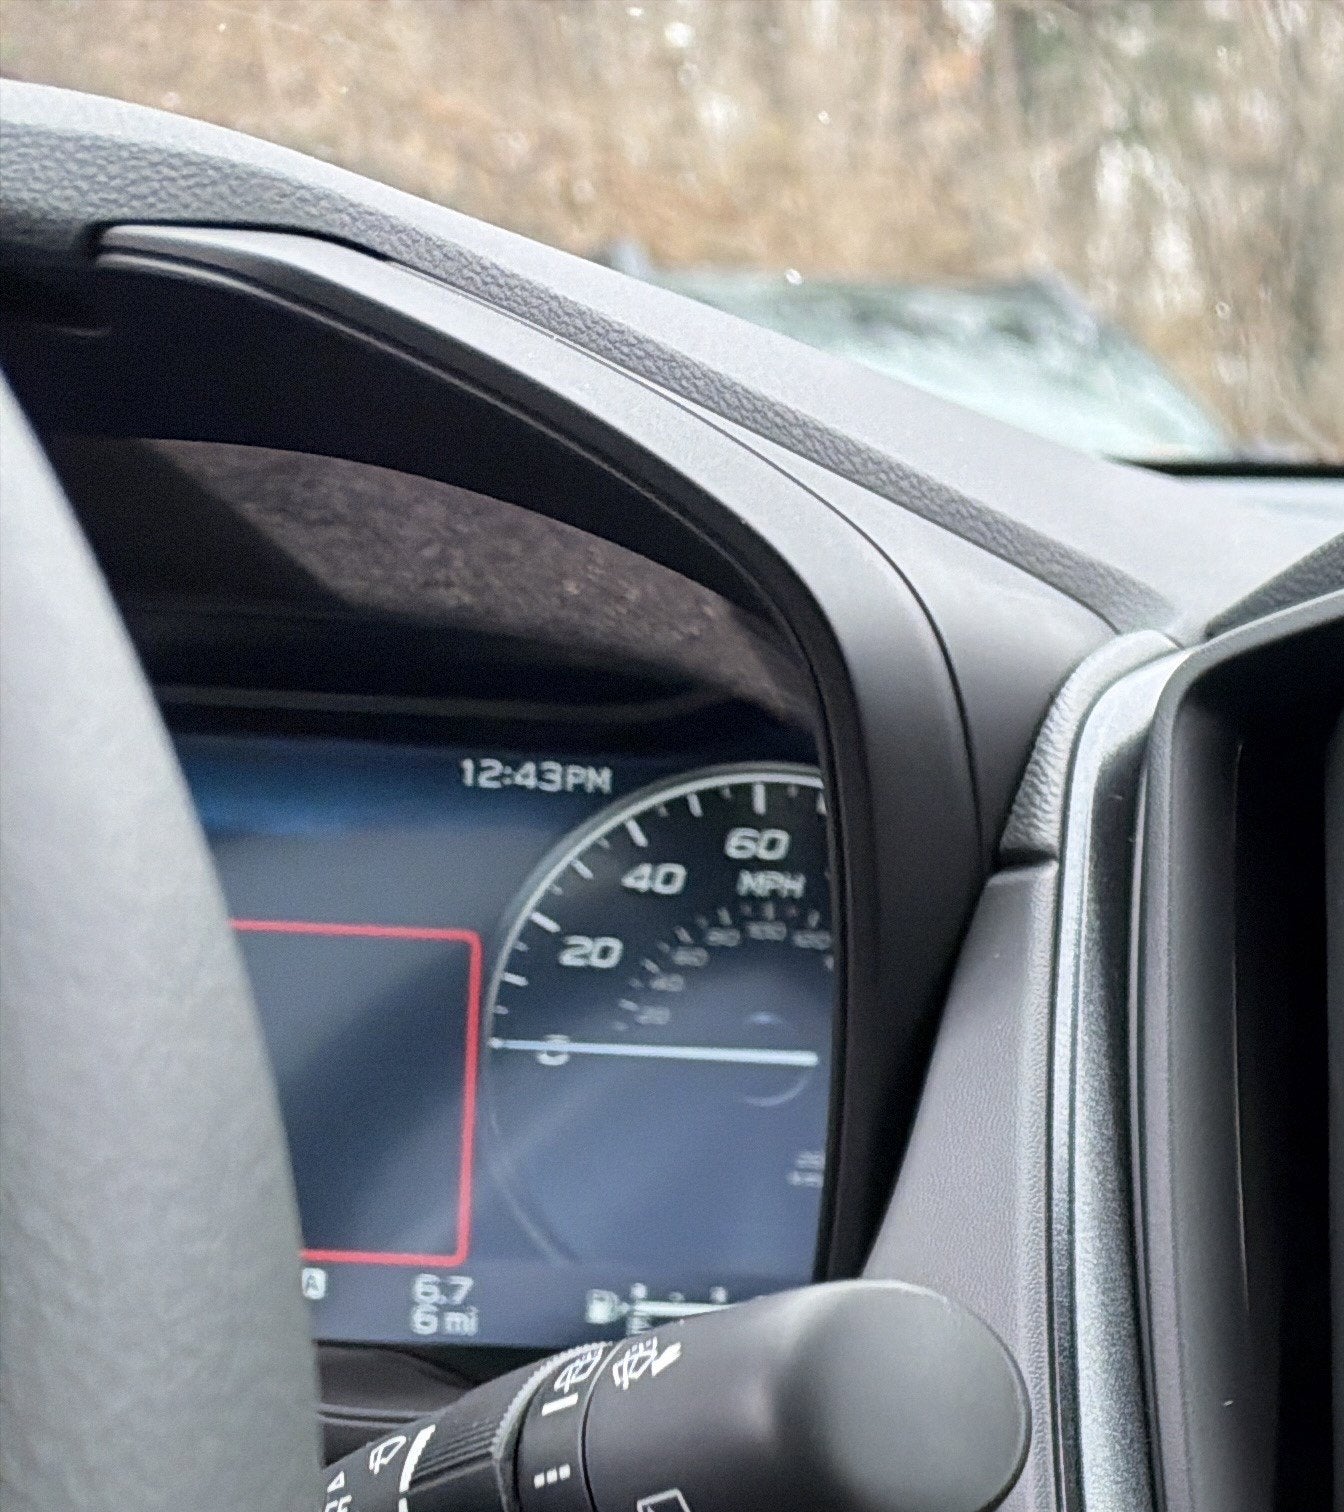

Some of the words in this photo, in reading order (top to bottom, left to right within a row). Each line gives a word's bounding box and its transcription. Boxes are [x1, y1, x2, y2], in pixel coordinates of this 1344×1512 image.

[725, 827, 790, 860] 60
[621, 862, 686, 895] 40
[560, 934, 624, 968] 20
[413, 1273, 473, 1305] 6.7
[411, 1303, 438, 1335] 6
[443, 1306, 479, 1336] mi
